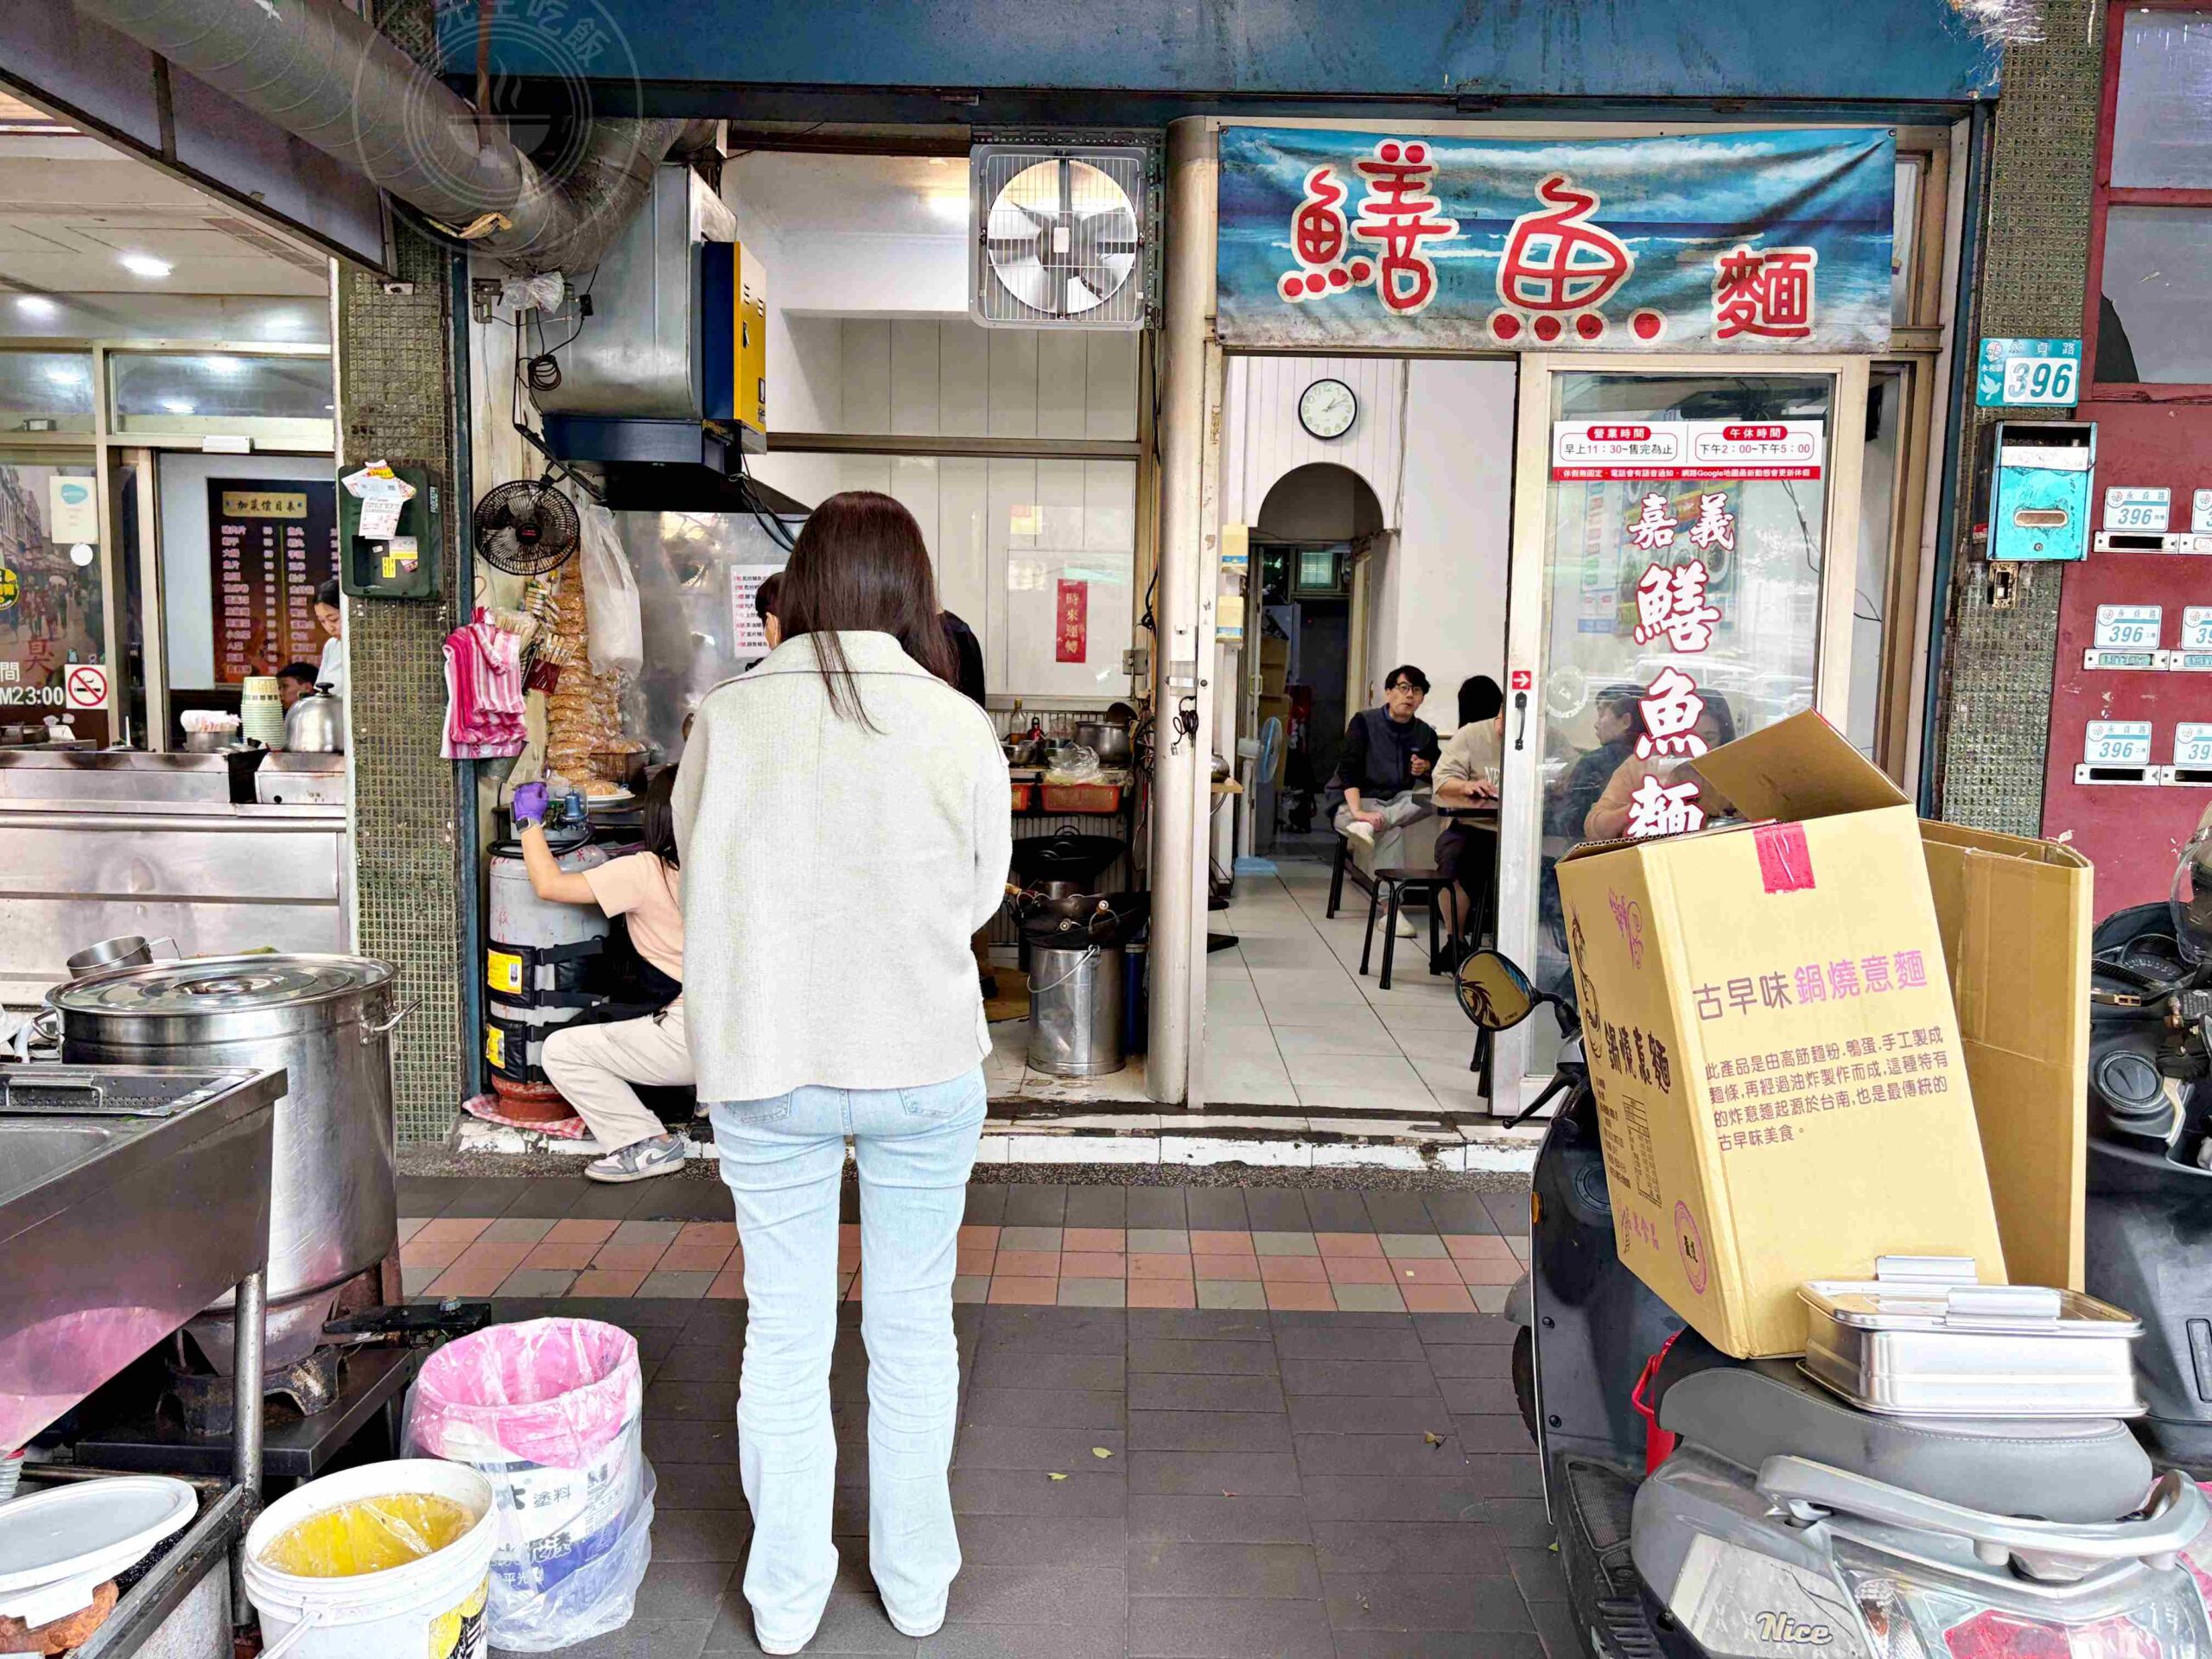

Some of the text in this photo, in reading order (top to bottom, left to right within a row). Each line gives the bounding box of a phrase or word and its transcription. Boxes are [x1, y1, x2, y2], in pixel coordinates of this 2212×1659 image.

[1279, 140, 1817, 342] 鱔魚麵
[2008, 340, 2076, 356] 永貞路
[2008, 363, 2073, 397] 396
[1593, 428, 1645, 439] 營業時間
[1730, 428, 1782, 439] 午休時間
[1628, 492, 1735, 550] 嘉義
[2118, 508, 2152, 524] 396
[2109, 626, 2144, 642] 396
[1627, 559, 1721, 836] 鱔魚麵
[2099, 742, 2133, 758] 396
[2188, 744, 2212, 760] 39
[1692, 950, 1928, 1021] 古早味鍋燒意麵
[1756, 1611, 1833, 1645] Nice
